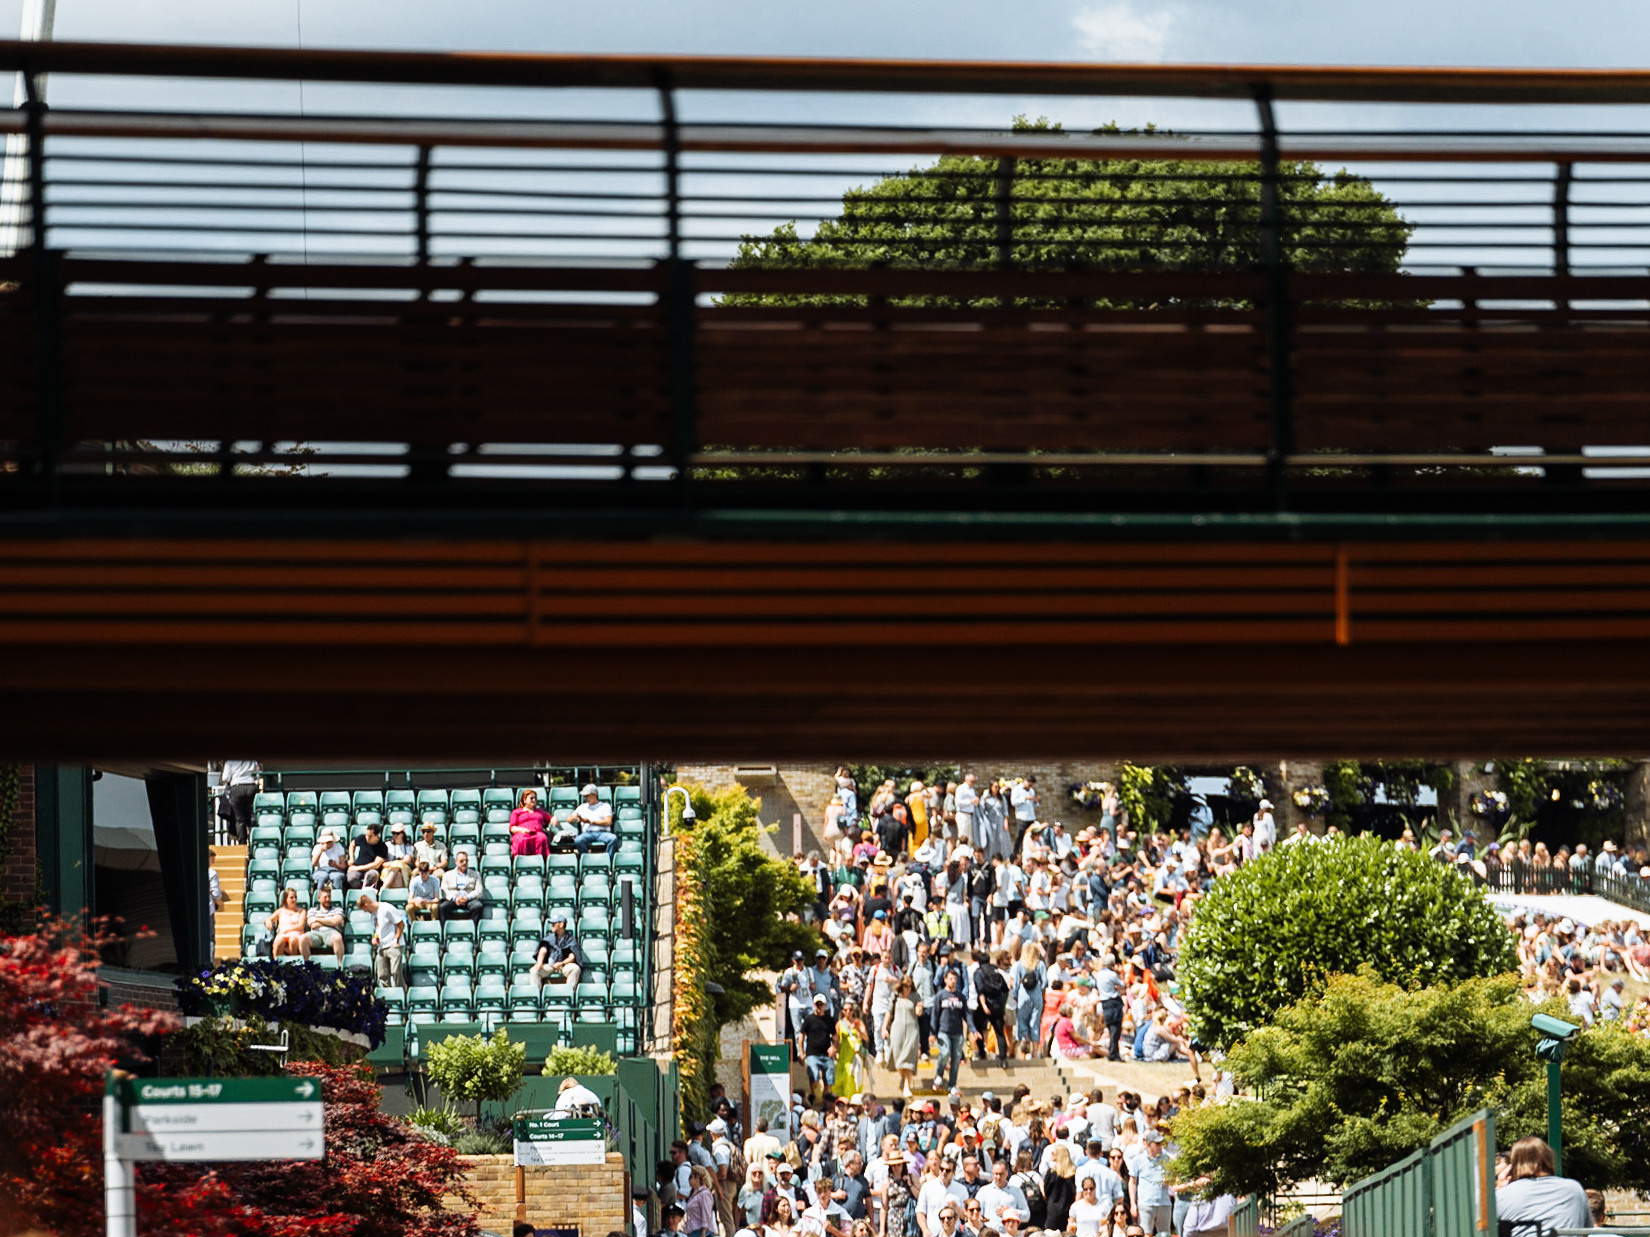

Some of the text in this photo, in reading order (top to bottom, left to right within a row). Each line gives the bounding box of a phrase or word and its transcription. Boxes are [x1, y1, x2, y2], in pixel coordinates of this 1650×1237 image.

[141, 1084, 222, 1098] Courts 15-17
[144, 1114, 197, 1125] Parkside
[171, 1142, 204, 1152] Lawn
